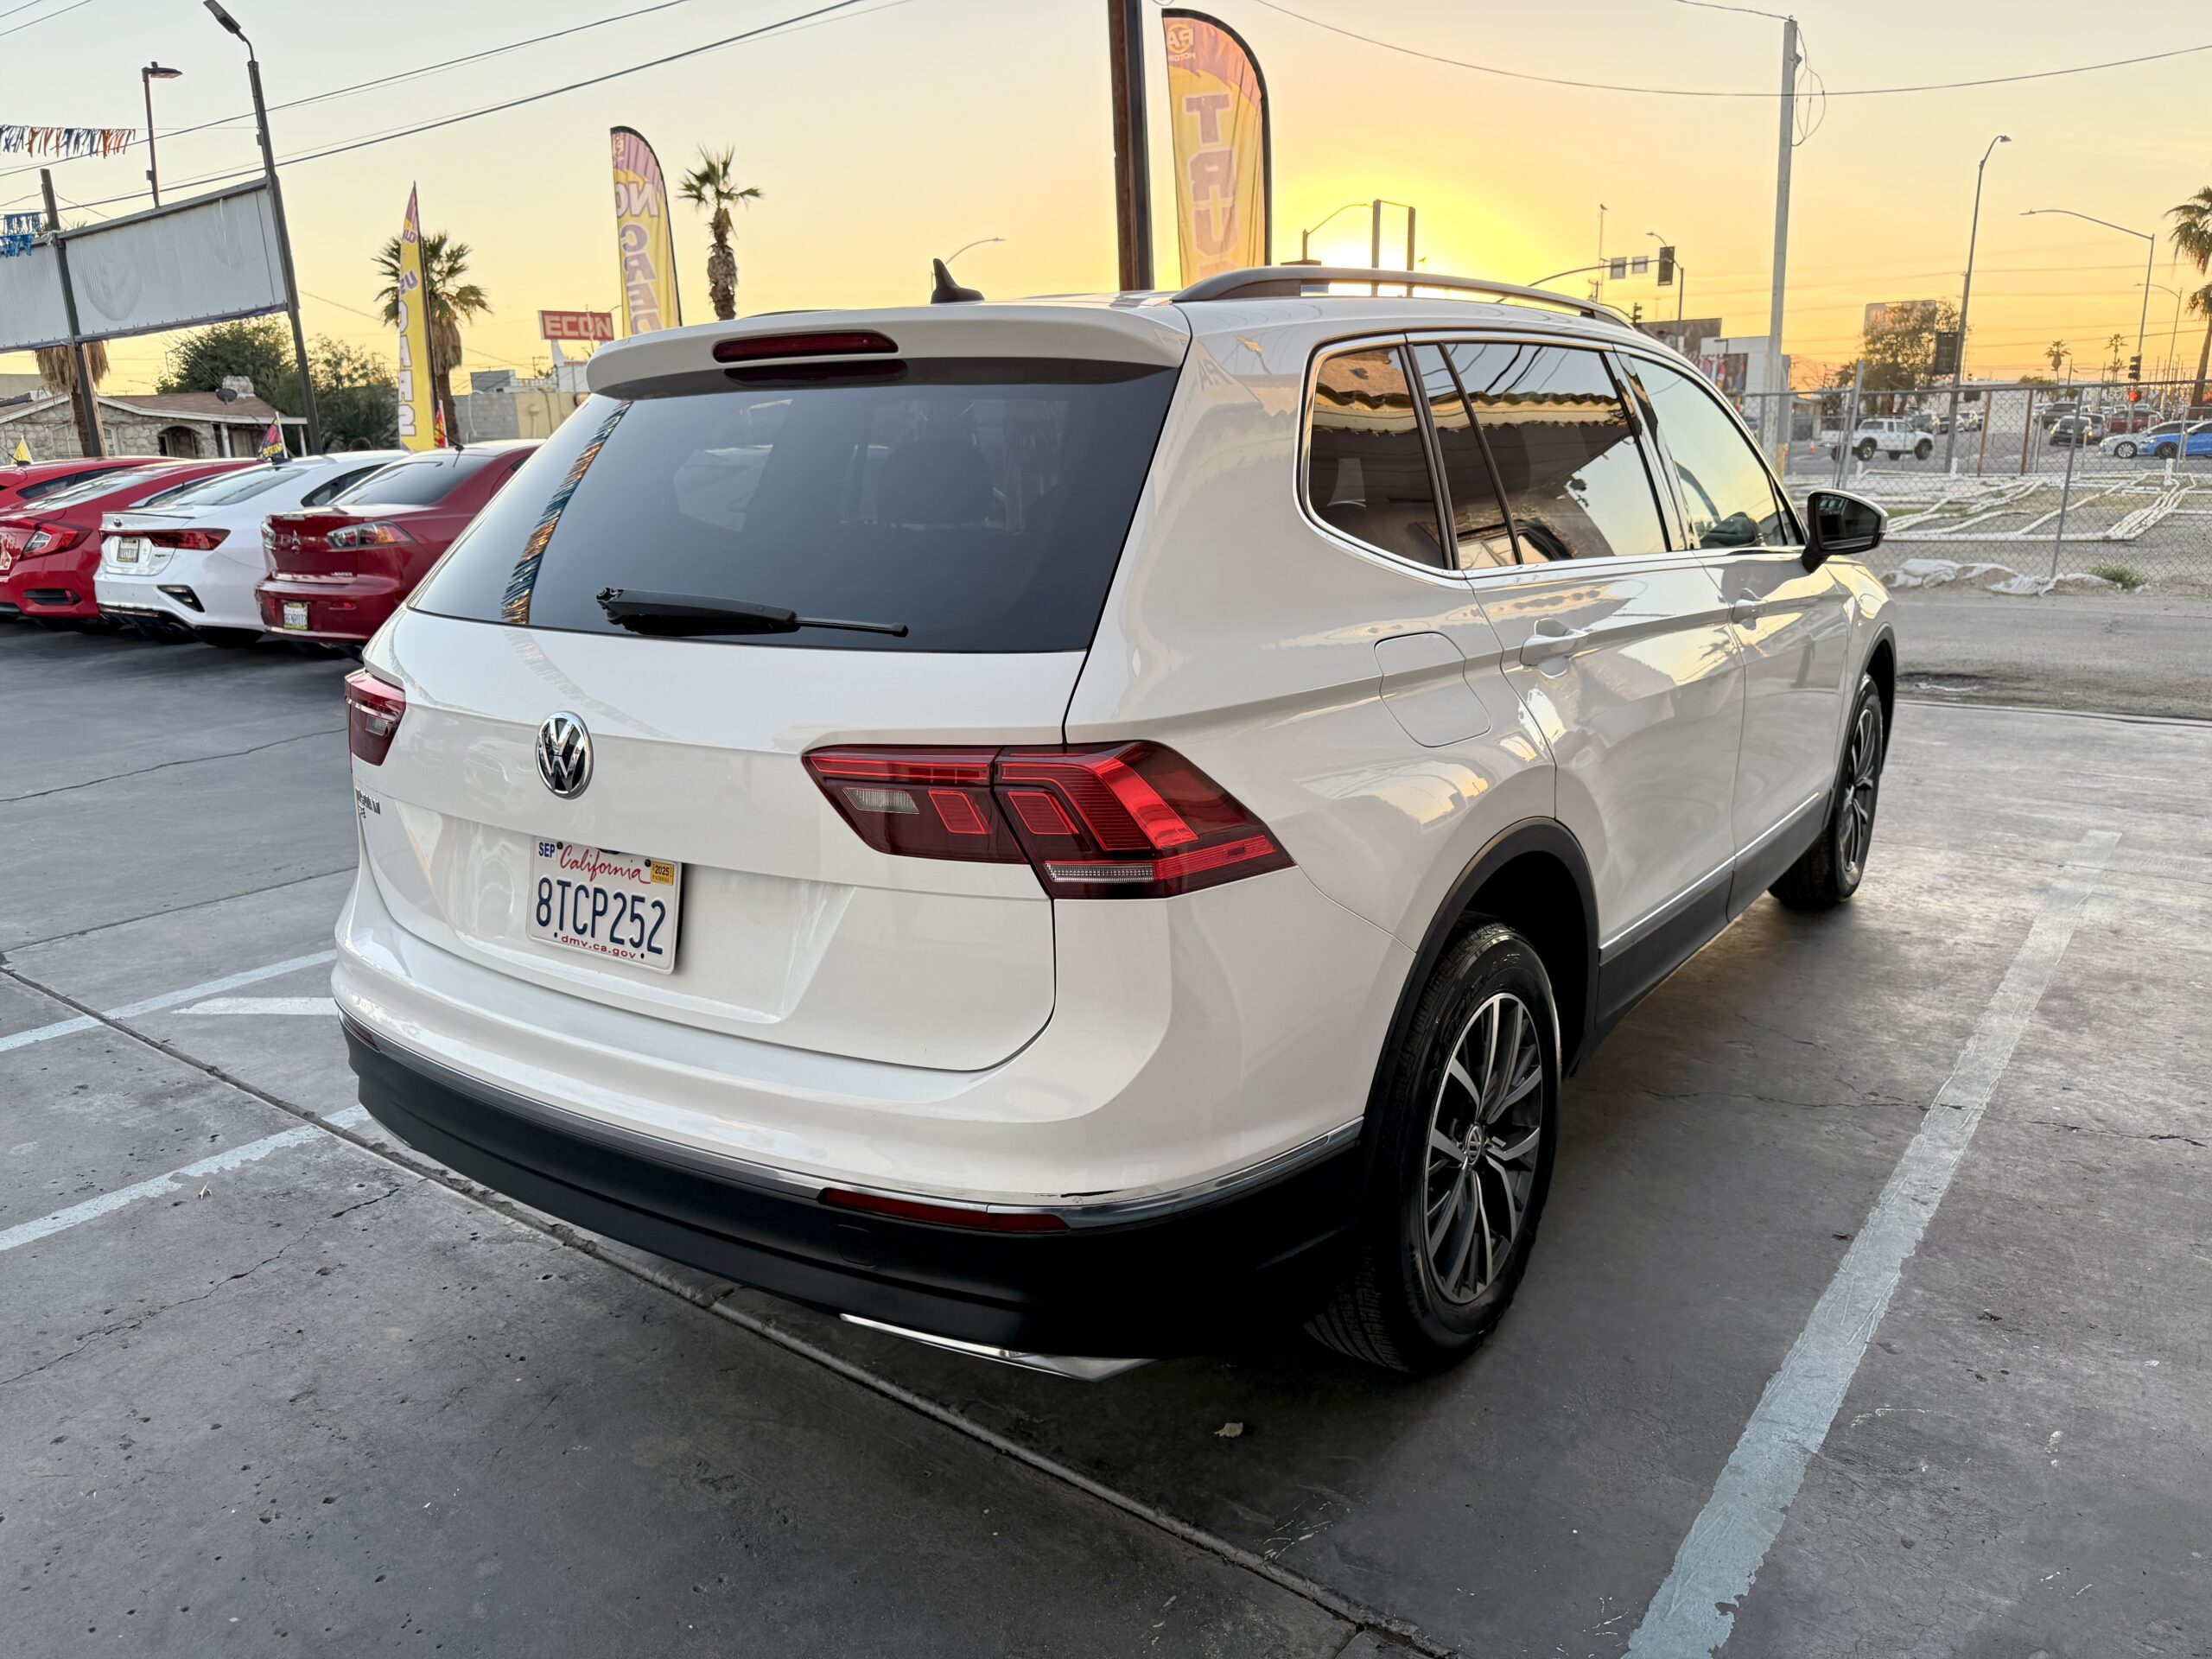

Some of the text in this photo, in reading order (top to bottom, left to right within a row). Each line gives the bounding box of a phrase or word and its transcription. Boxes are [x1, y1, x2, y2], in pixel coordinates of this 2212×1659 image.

[543, 315, 613, 337] ECON
[538, 842, 556, 858] SEP
[560, 844, 652, 884] California
[655, 865, 670, 876] 2025
[536, 876, 667, 955] 8TCP252
[562, 935, 637, 959] dmv.ca.gov
